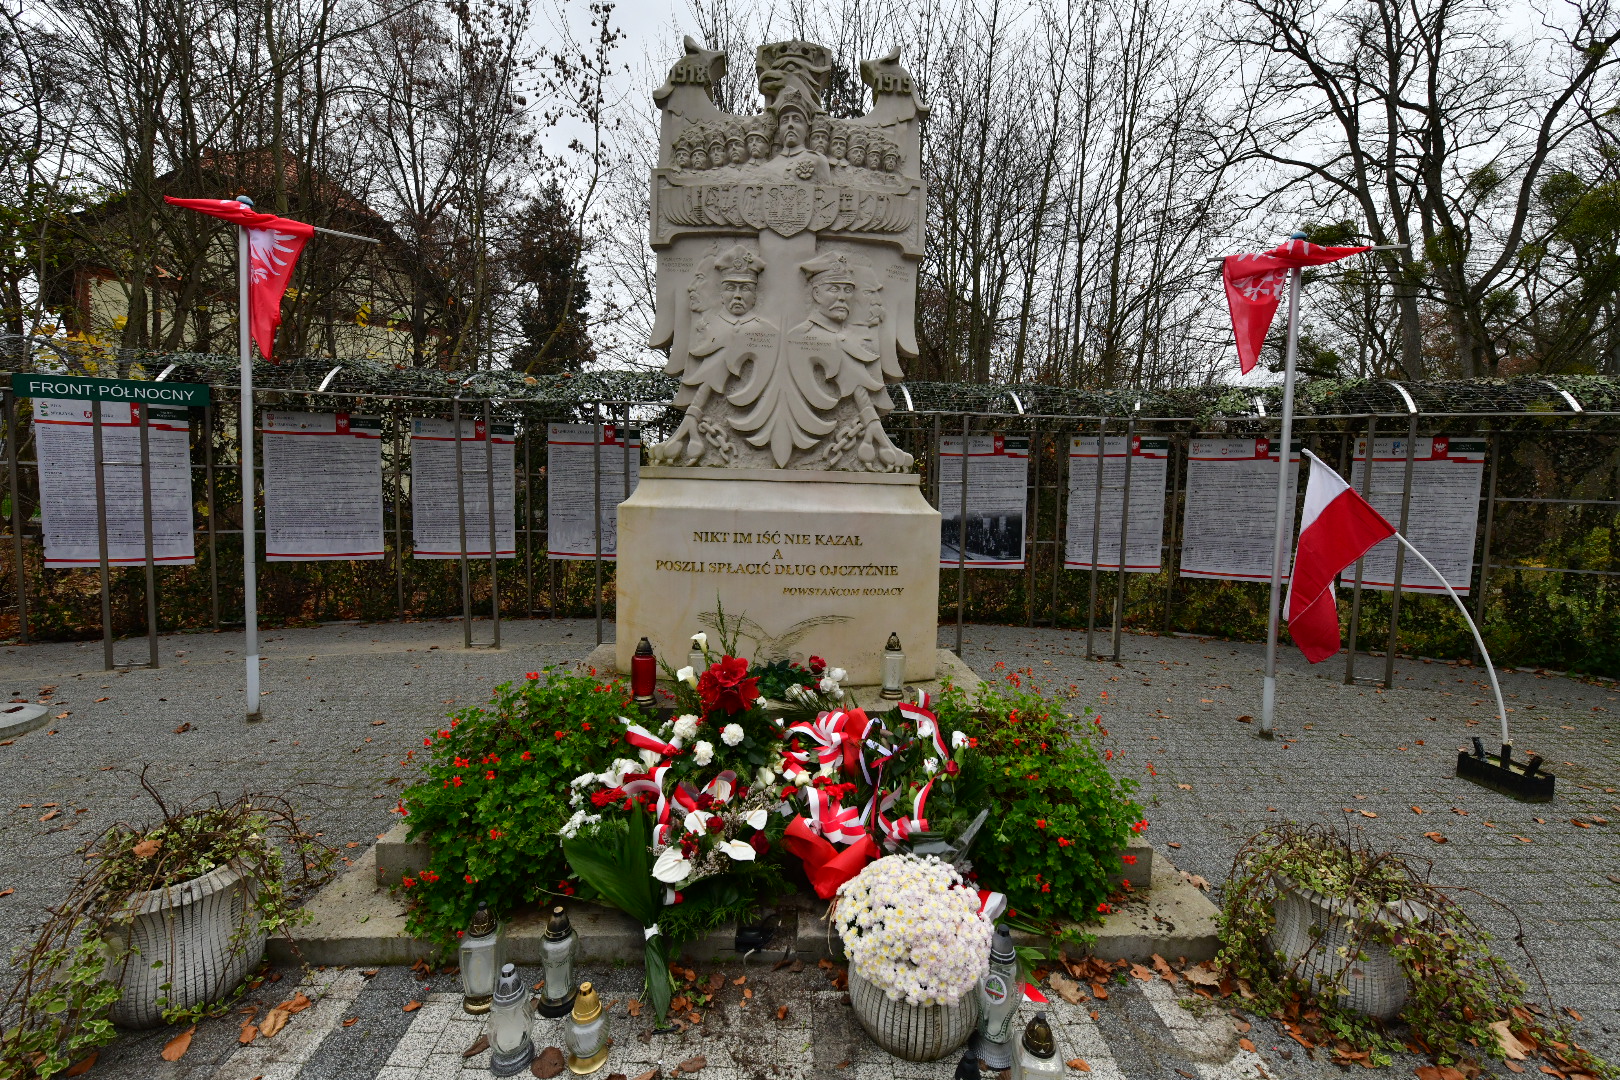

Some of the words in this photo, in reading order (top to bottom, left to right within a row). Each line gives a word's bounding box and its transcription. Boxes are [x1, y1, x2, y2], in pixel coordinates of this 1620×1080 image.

[671, 64, 706, 84] 1918
[876, 73, 912, 93] 1919
[29, 381, 94, 396] FRONT
[98, 384, 195, 400] PÓŁNOCNY
[693, 531, 730, 544] NIKT
[733, 532, 752, 545] IM
[756, 530, 781, 545] IŚĆ
[784, 533, 811, 546] NIE
[814, 534, 863, 547] KAZAŁ
[772, 549, 783, 560] A
[655, 559, 705, 573] POSZLI
[708, 561, 771, 576] SPŁACIĆ
[775, 564, 816, 576] DŁUG
[820, 562, 899, 577] OJCZYŹNIE
[782, 586, 860, 597] POWSTAŃCOM
[863, 587, 904, 597] RODACY
